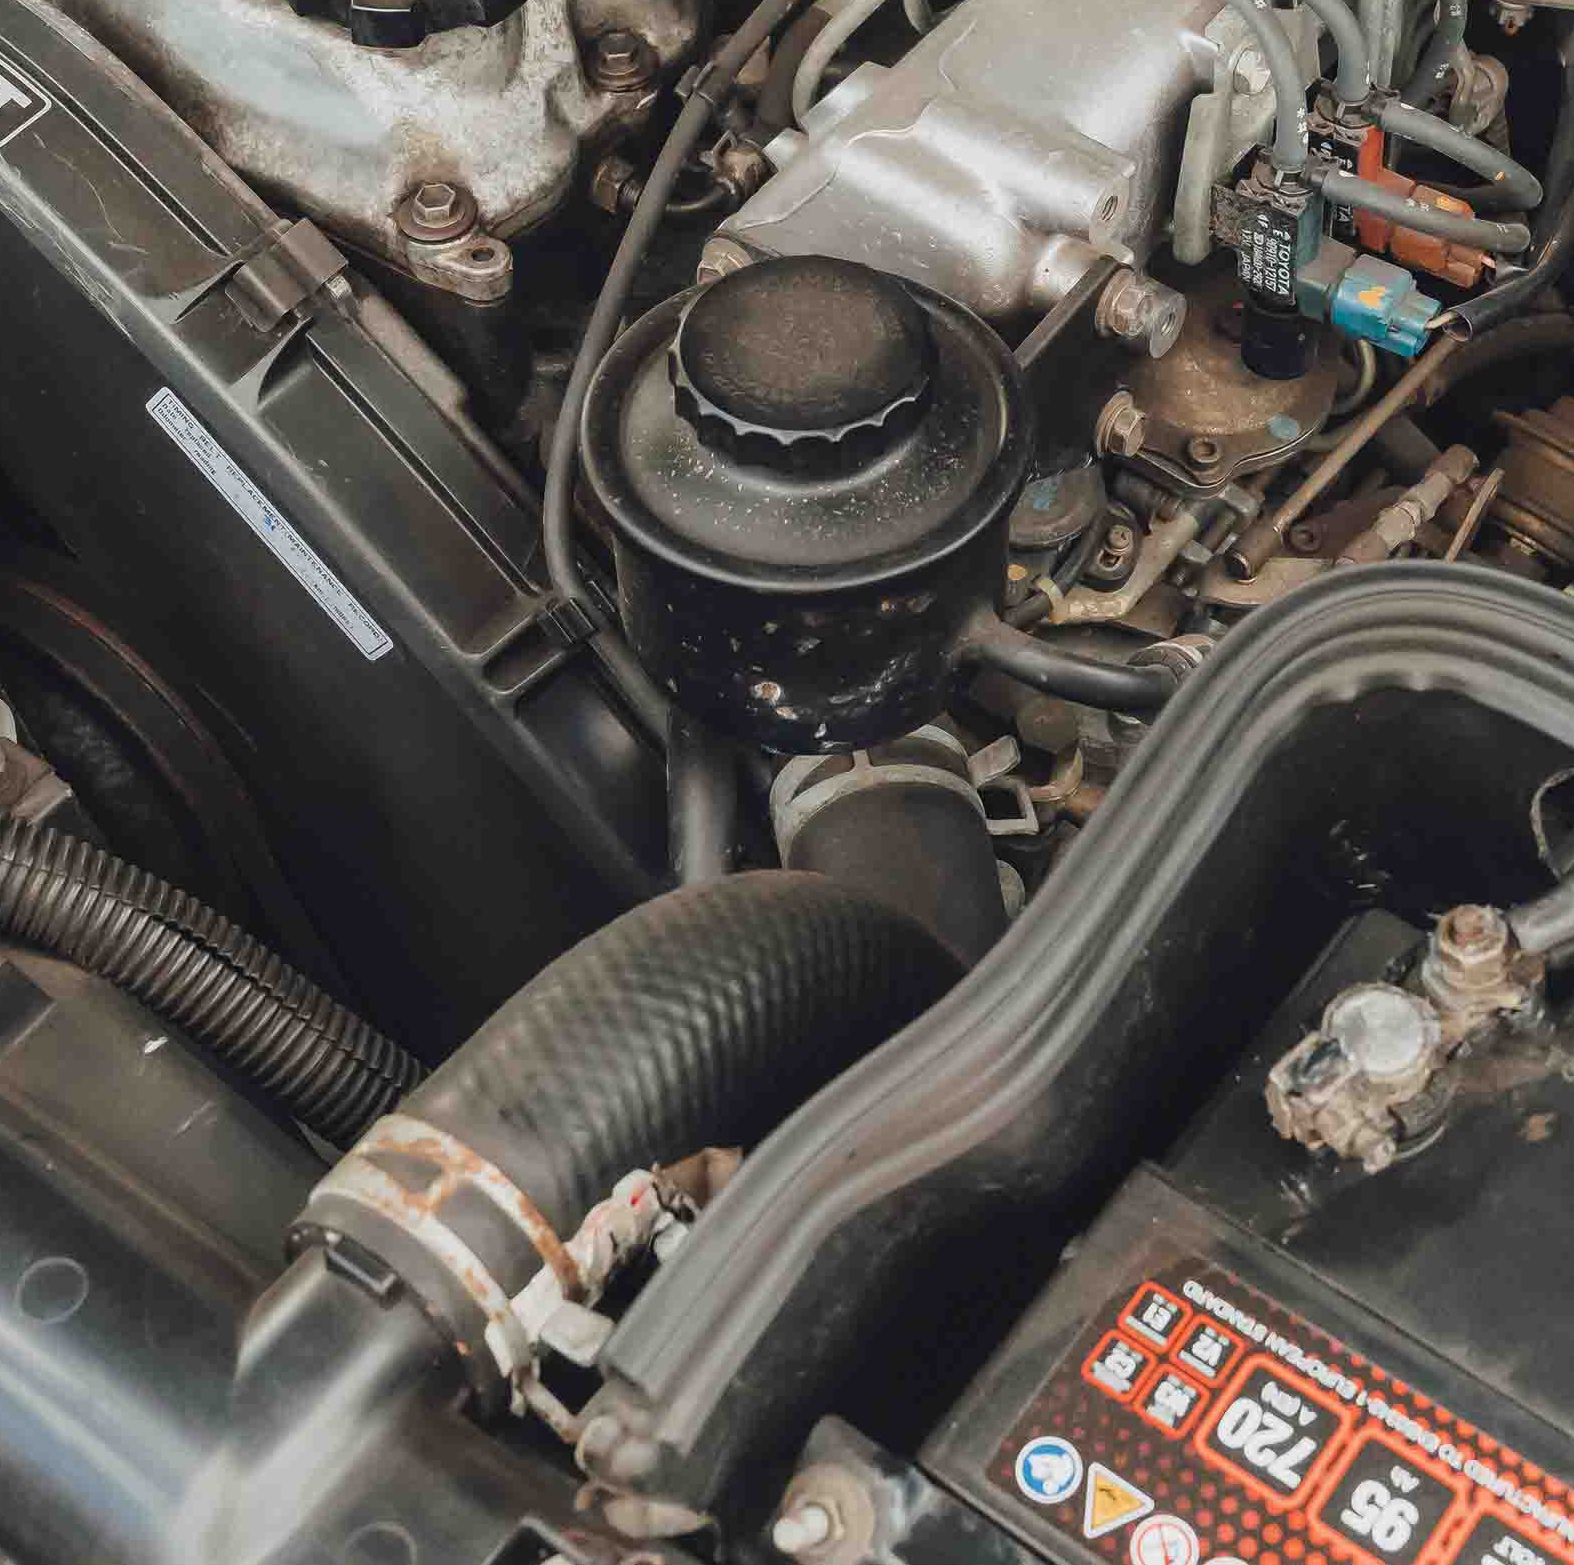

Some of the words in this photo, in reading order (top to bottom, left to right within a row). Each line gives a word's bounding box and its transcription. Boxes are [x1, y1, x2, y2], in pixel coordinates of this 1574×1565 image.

[1275, 243, 1292, 295] TOYOTA
[166, 399, 195, 430] TIMING
[198, 435, 223, 461] BELT
[224, 464, 286, 532] REPLACEMENT
[285, 532, 344, 597] MAINTENANCE
[1210, 1390, 1323, 1490] 720
[1336, 1473, 1426, 1558] 95
